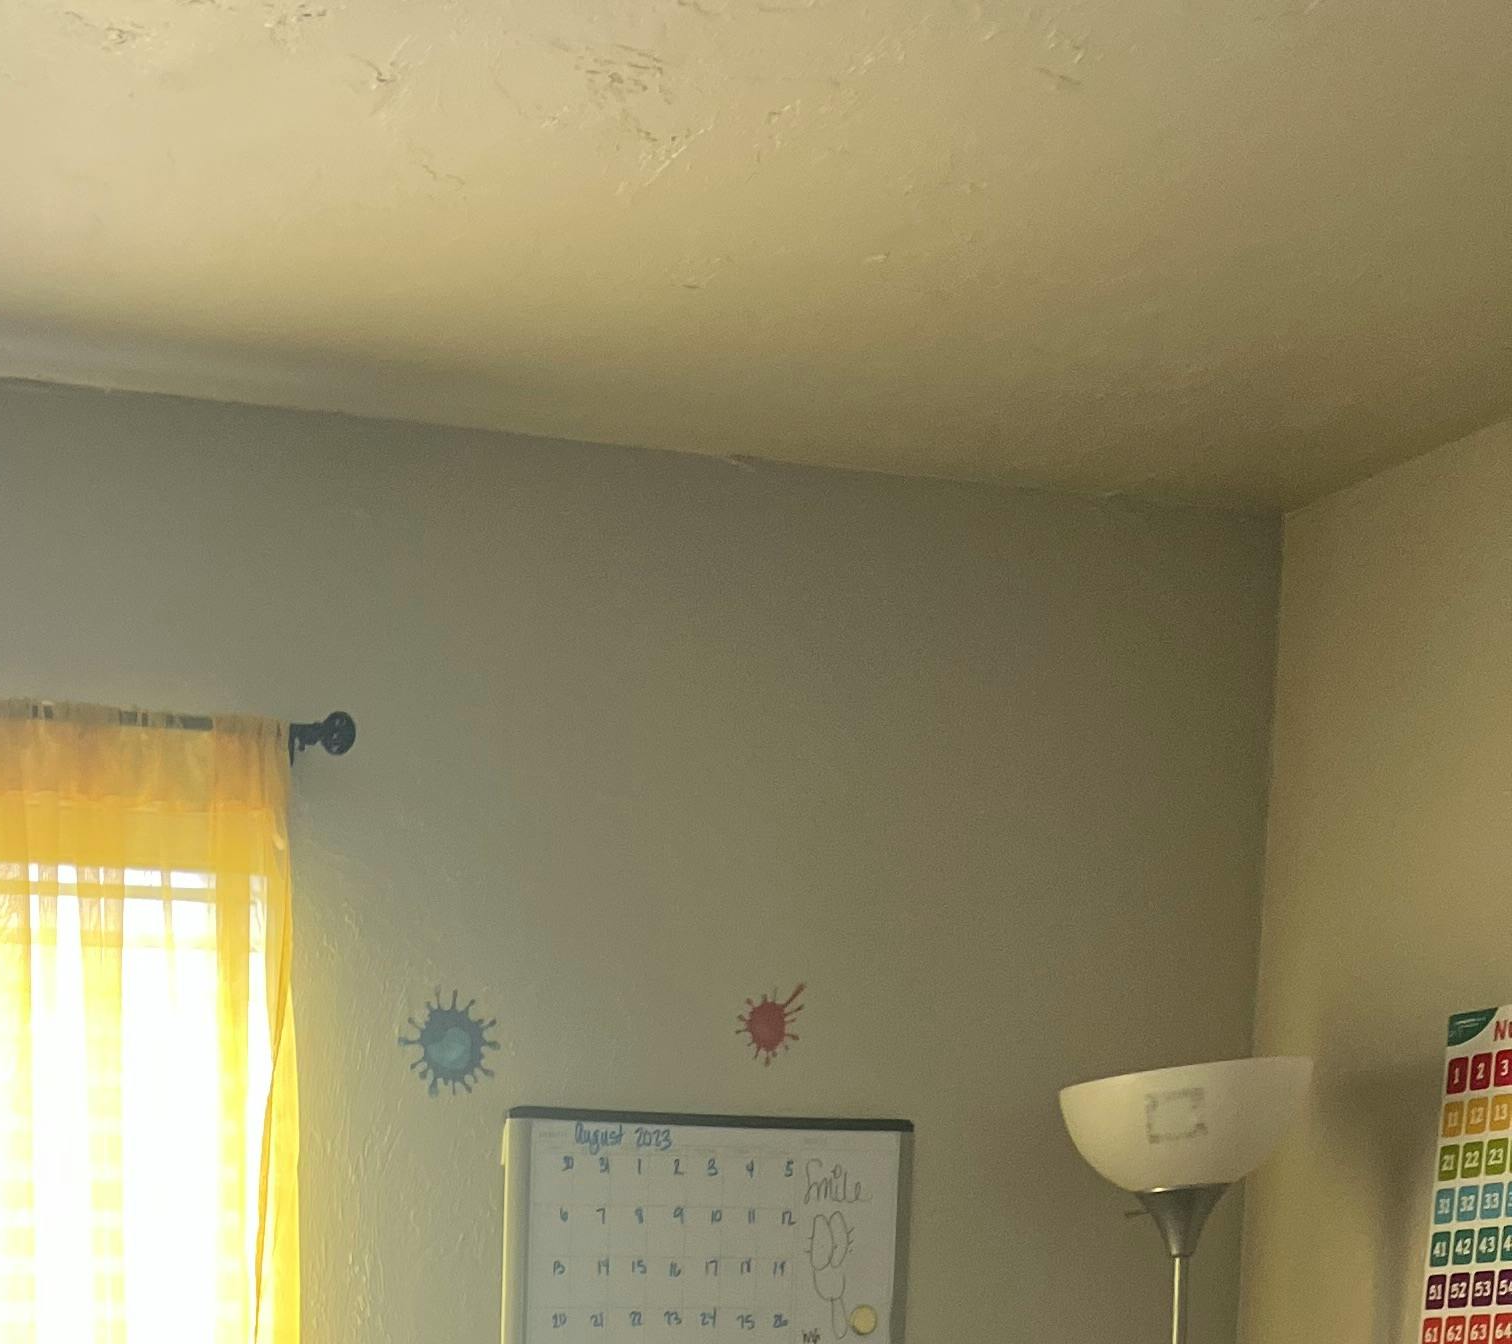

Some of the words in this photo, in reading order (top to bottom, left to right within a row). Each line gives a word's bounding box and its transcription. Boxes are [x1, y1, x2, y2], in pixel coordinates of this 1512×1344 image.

[1453, 1067, 1459, 1085] 1
[1476, 1062, 1486, 1080] 2
[1500, 1059, 1509, 1077] 3
[1447, 1111, 1459, 1127] 11
[1470, 1107, 1485, 1125] 12
[1494, 1103, 1508, 1122] 13
[575, 1120, 623, 1155] August
[635, 1126, 672, 1151] 2023
[674, 1158, 684, 1176] 2
[707, 1158, 718, 1177] 3
[746, 1159, 754, 1178] 4
[784, 1160, 794, 1178] 5
[1441, 1154, 1455, 1172] 21
[1464, 1150, 1480, 1169] 22
[1488, 1147, 1504, 1166] 23
[803, 1157, 863, 1205] Smile
[1459, 1194, 1476, 1213] 32
[1483, 1192, 1500, 1210] 33
[560, 1207, 568, 1222] 6
[596, 1207, 606, 1224] 7
[673, 1206, 684, 1224] 9
[711, 1208, 722, 1224] 10
[748, 1208, 756, 1224] 11
[781, 1208, 796, 1225] 12
[1433, 1241, 1448, 1257] 41
[1455, 1238, 1472, 1255] 42
[1479, 1236, 1496, 1254] 43
[598, 1258, 610, 1276] 14
[631, 1259, 648, 1274] 15
[669, 1261, 682, 1277] 16
[705, 1259, 718, 1277] 17
[1428, 1283, 1443, 1301] 51
[1450, 1281, 1467, 1299] 52
[1474, 1279, 1492, 1297] 53
[552, 1312, 568, 1329] 20
[590, 1312, 605, 1328] 21
[629, 1311, 643, 1327] 22
[664, 1310, 682, 1326] 23
[699, 1306, 717, 1329] 24
[736, 1314, 755, 1330] 25
[1424, 1326, 1440, 1343] 61
[1446, 1324, 1464, 1341] 62
[1469, 1323, 1487, 1341] 63
[1494, 1321, 1512, 1340] 64
